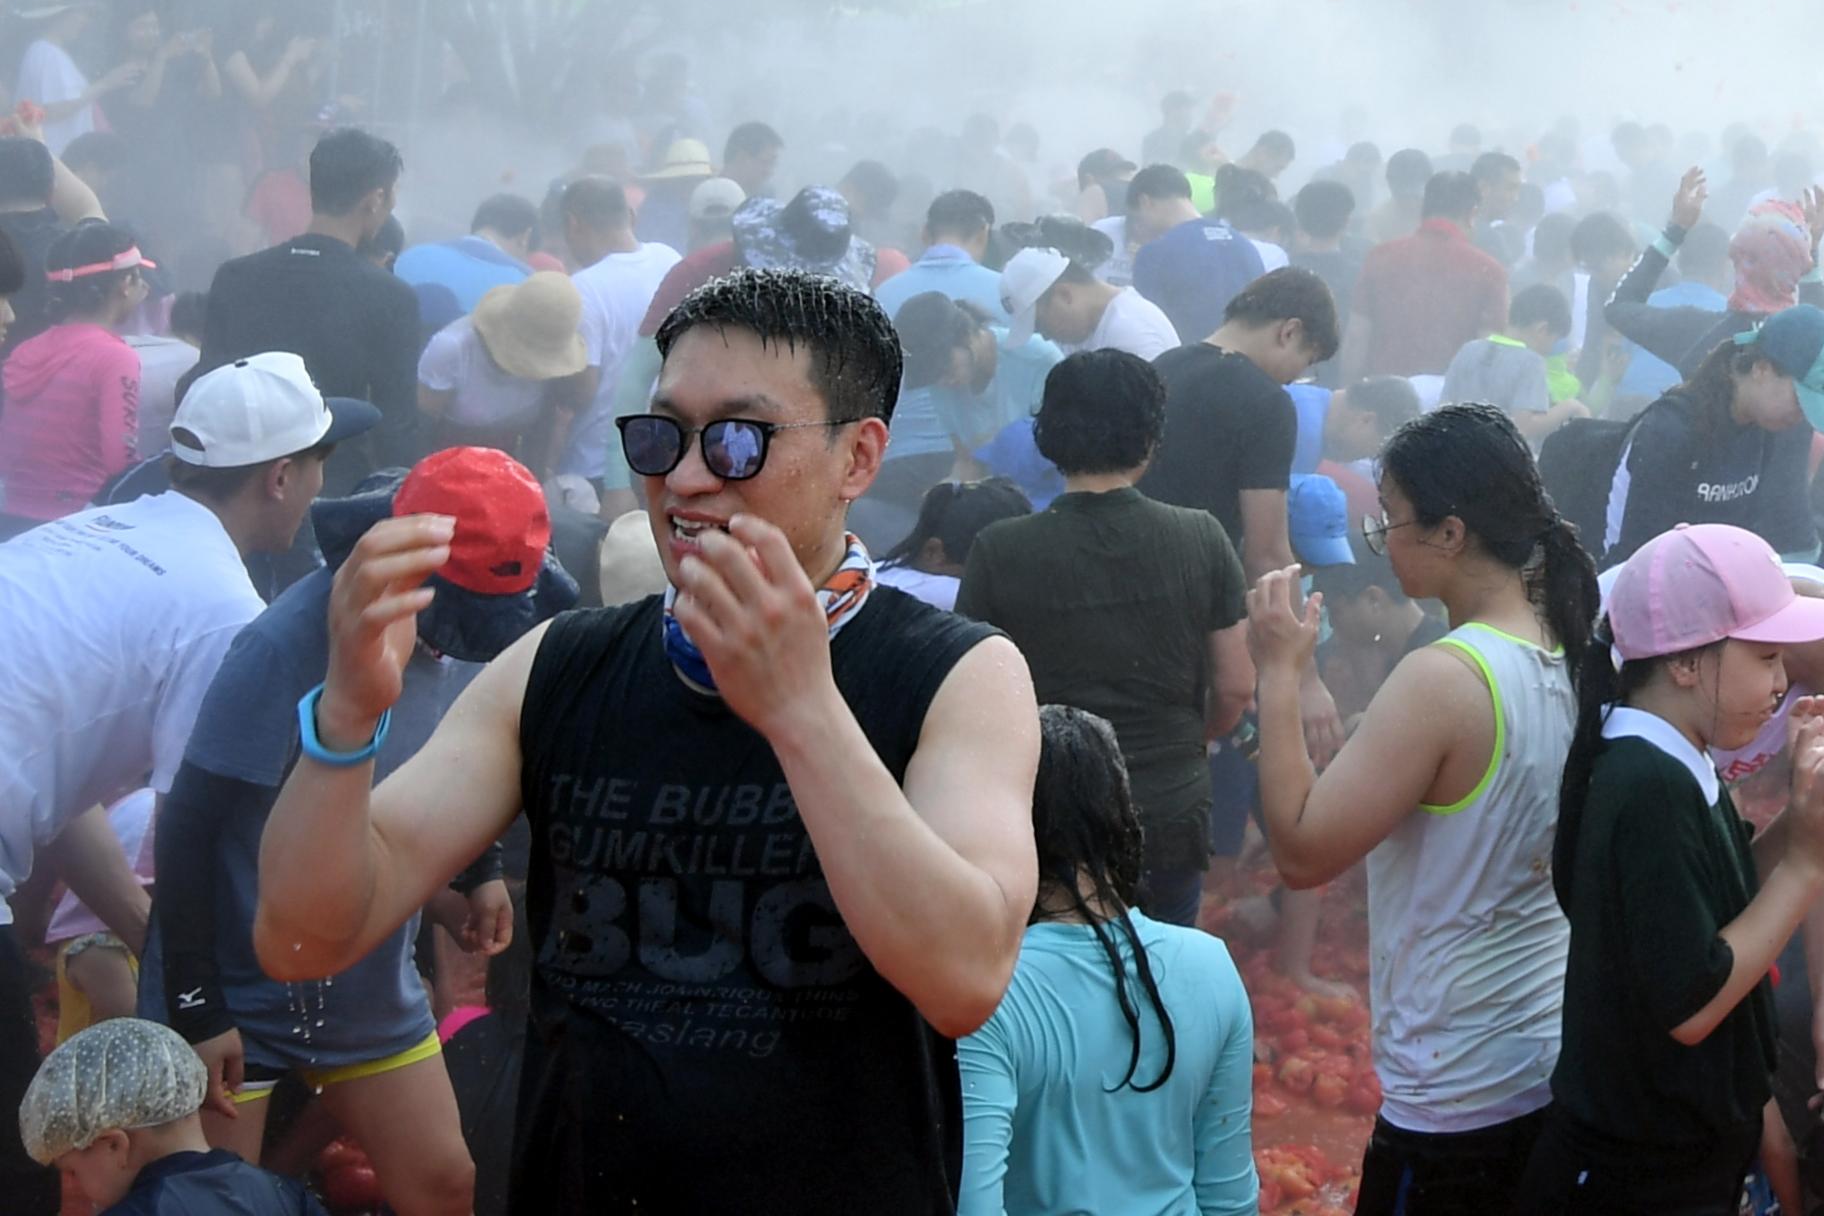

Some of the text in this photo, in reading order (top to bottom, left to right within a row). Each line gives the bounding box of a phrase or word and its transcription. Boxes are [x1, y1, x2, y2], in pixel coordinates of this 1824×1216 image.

[548, 773, 799, 827] THE BUBB
[537, 871, 863, 989] BUG
